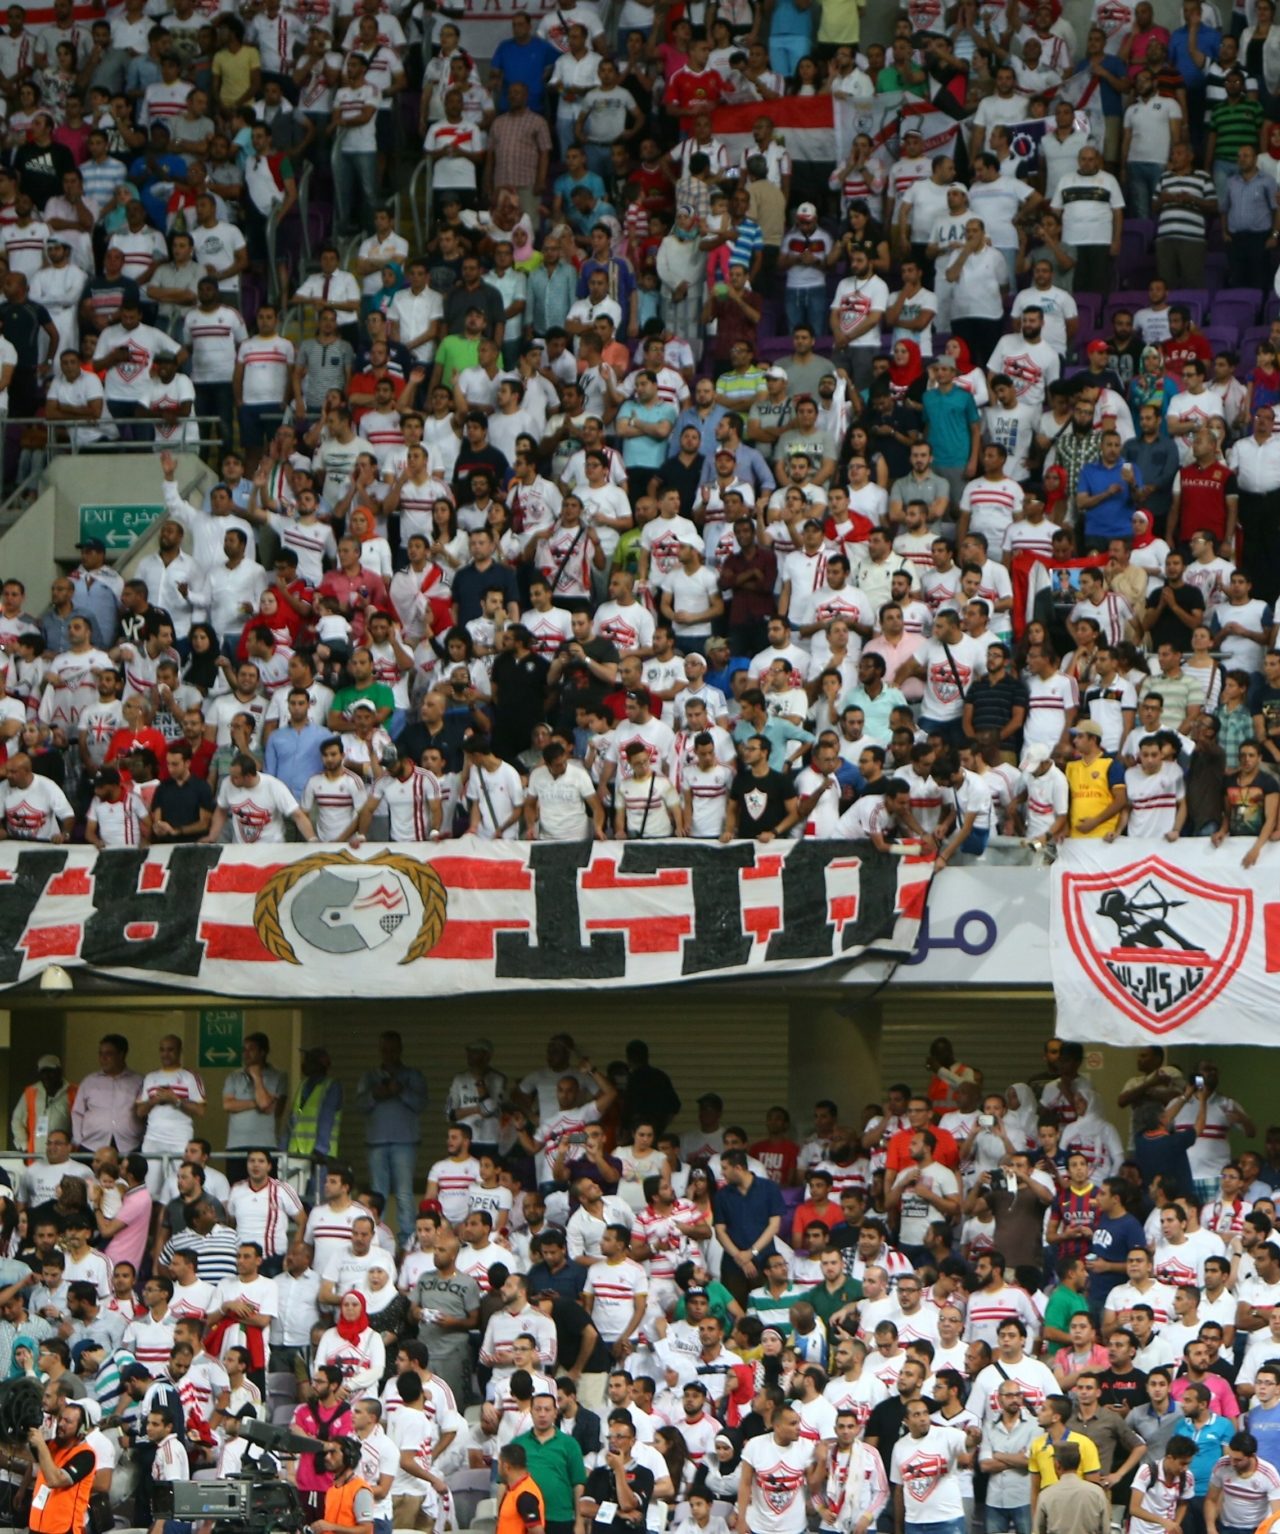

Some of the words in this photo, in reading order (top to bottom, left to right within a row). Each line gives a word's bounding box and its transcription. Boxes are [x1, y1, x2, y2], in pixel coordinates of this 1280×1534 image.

[86, 511, 114, 524] EXIT
[122, 510, 159, 527] مخرج
[207, 1023, 233, 1037] EXIT
[469, 1196, 500, 1211] OPEN
[1064, 1211, 1095, 1220] QATAR
[418, 1281, 469, 1297] adidas
